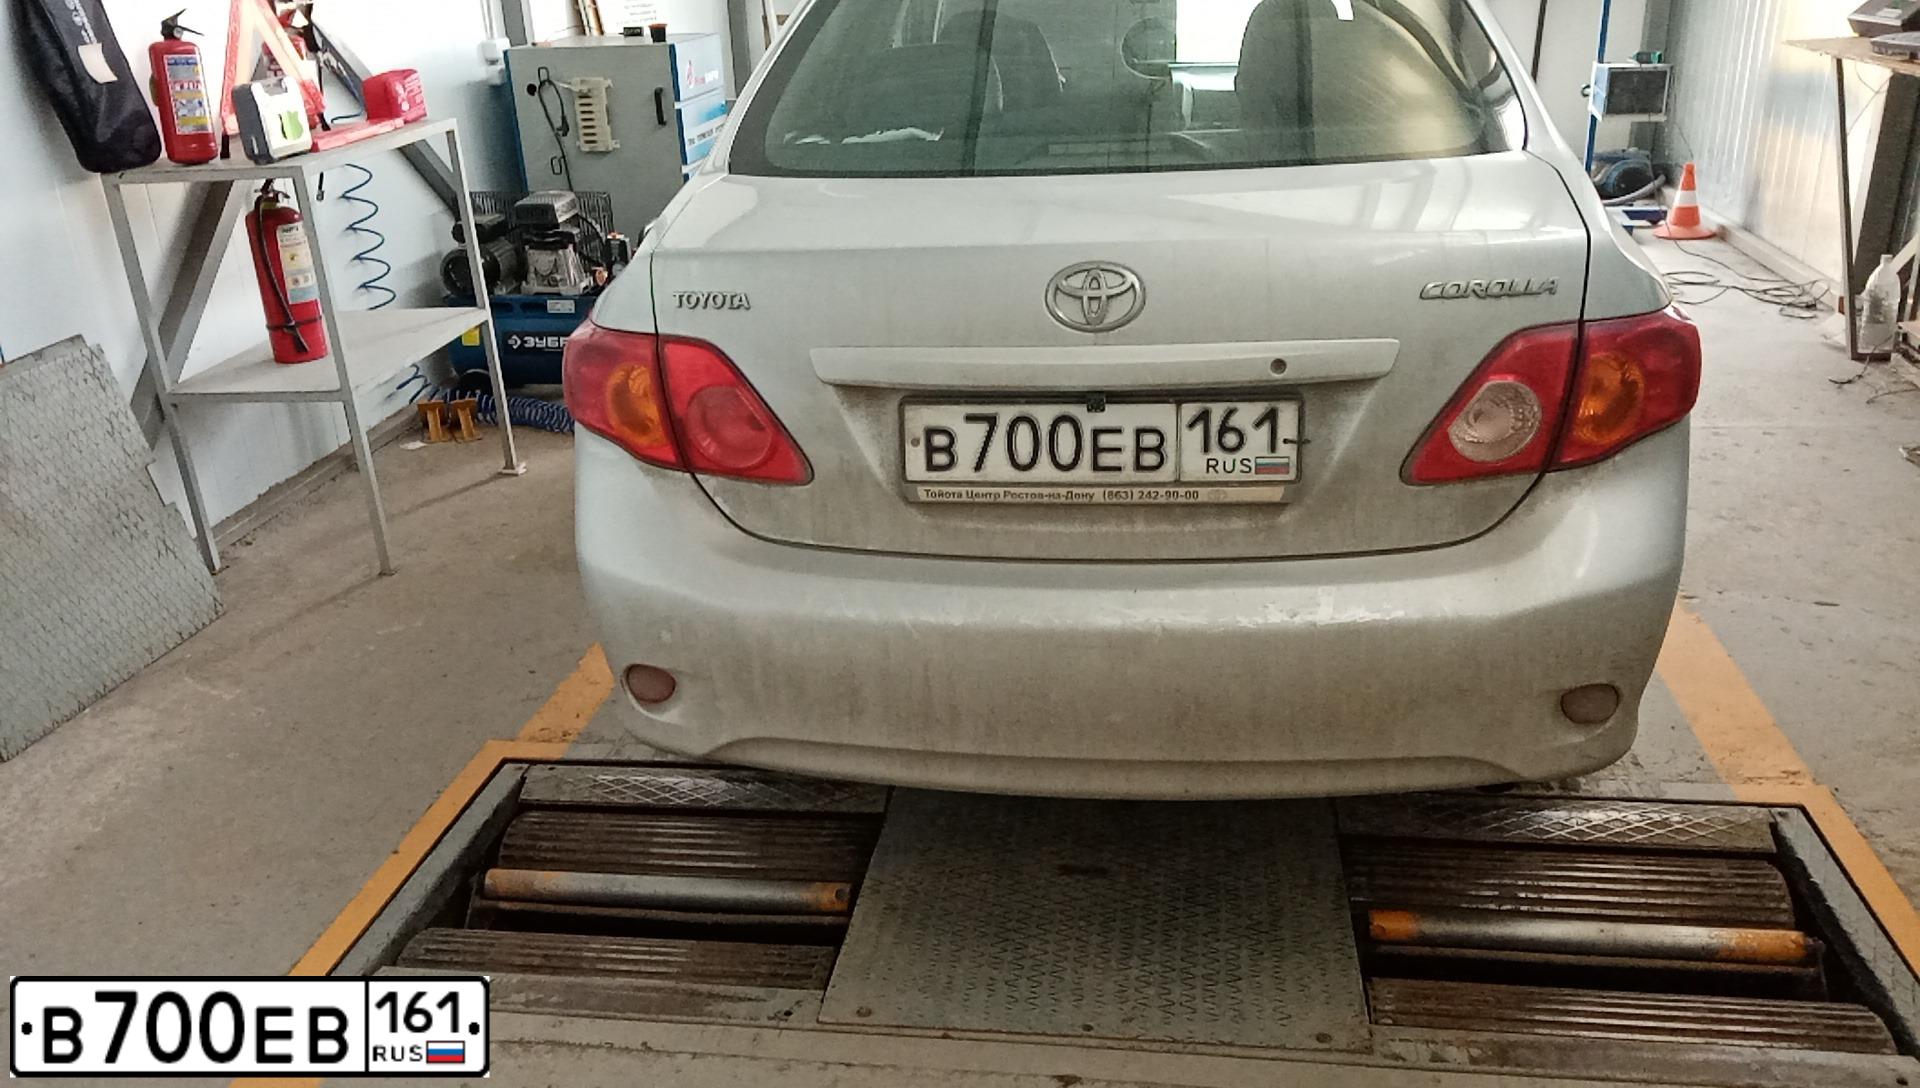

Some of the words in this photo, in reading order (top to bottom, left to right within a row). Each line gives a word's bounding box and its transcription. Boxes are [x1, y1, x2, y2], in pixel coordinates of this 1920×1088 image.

[1419, 277, 1558, 300] COROLLA
[672, 291, 751, 310] TOYOTA
[1186, 407, 1280, 454] 161
[1205, 457, 1253, 474] RUS
[924, 488, 963, 499] Тойота
[966, 490, 1001, 501] Центр
[1003, 489, 1096, 501] Ростов-на-Дону
